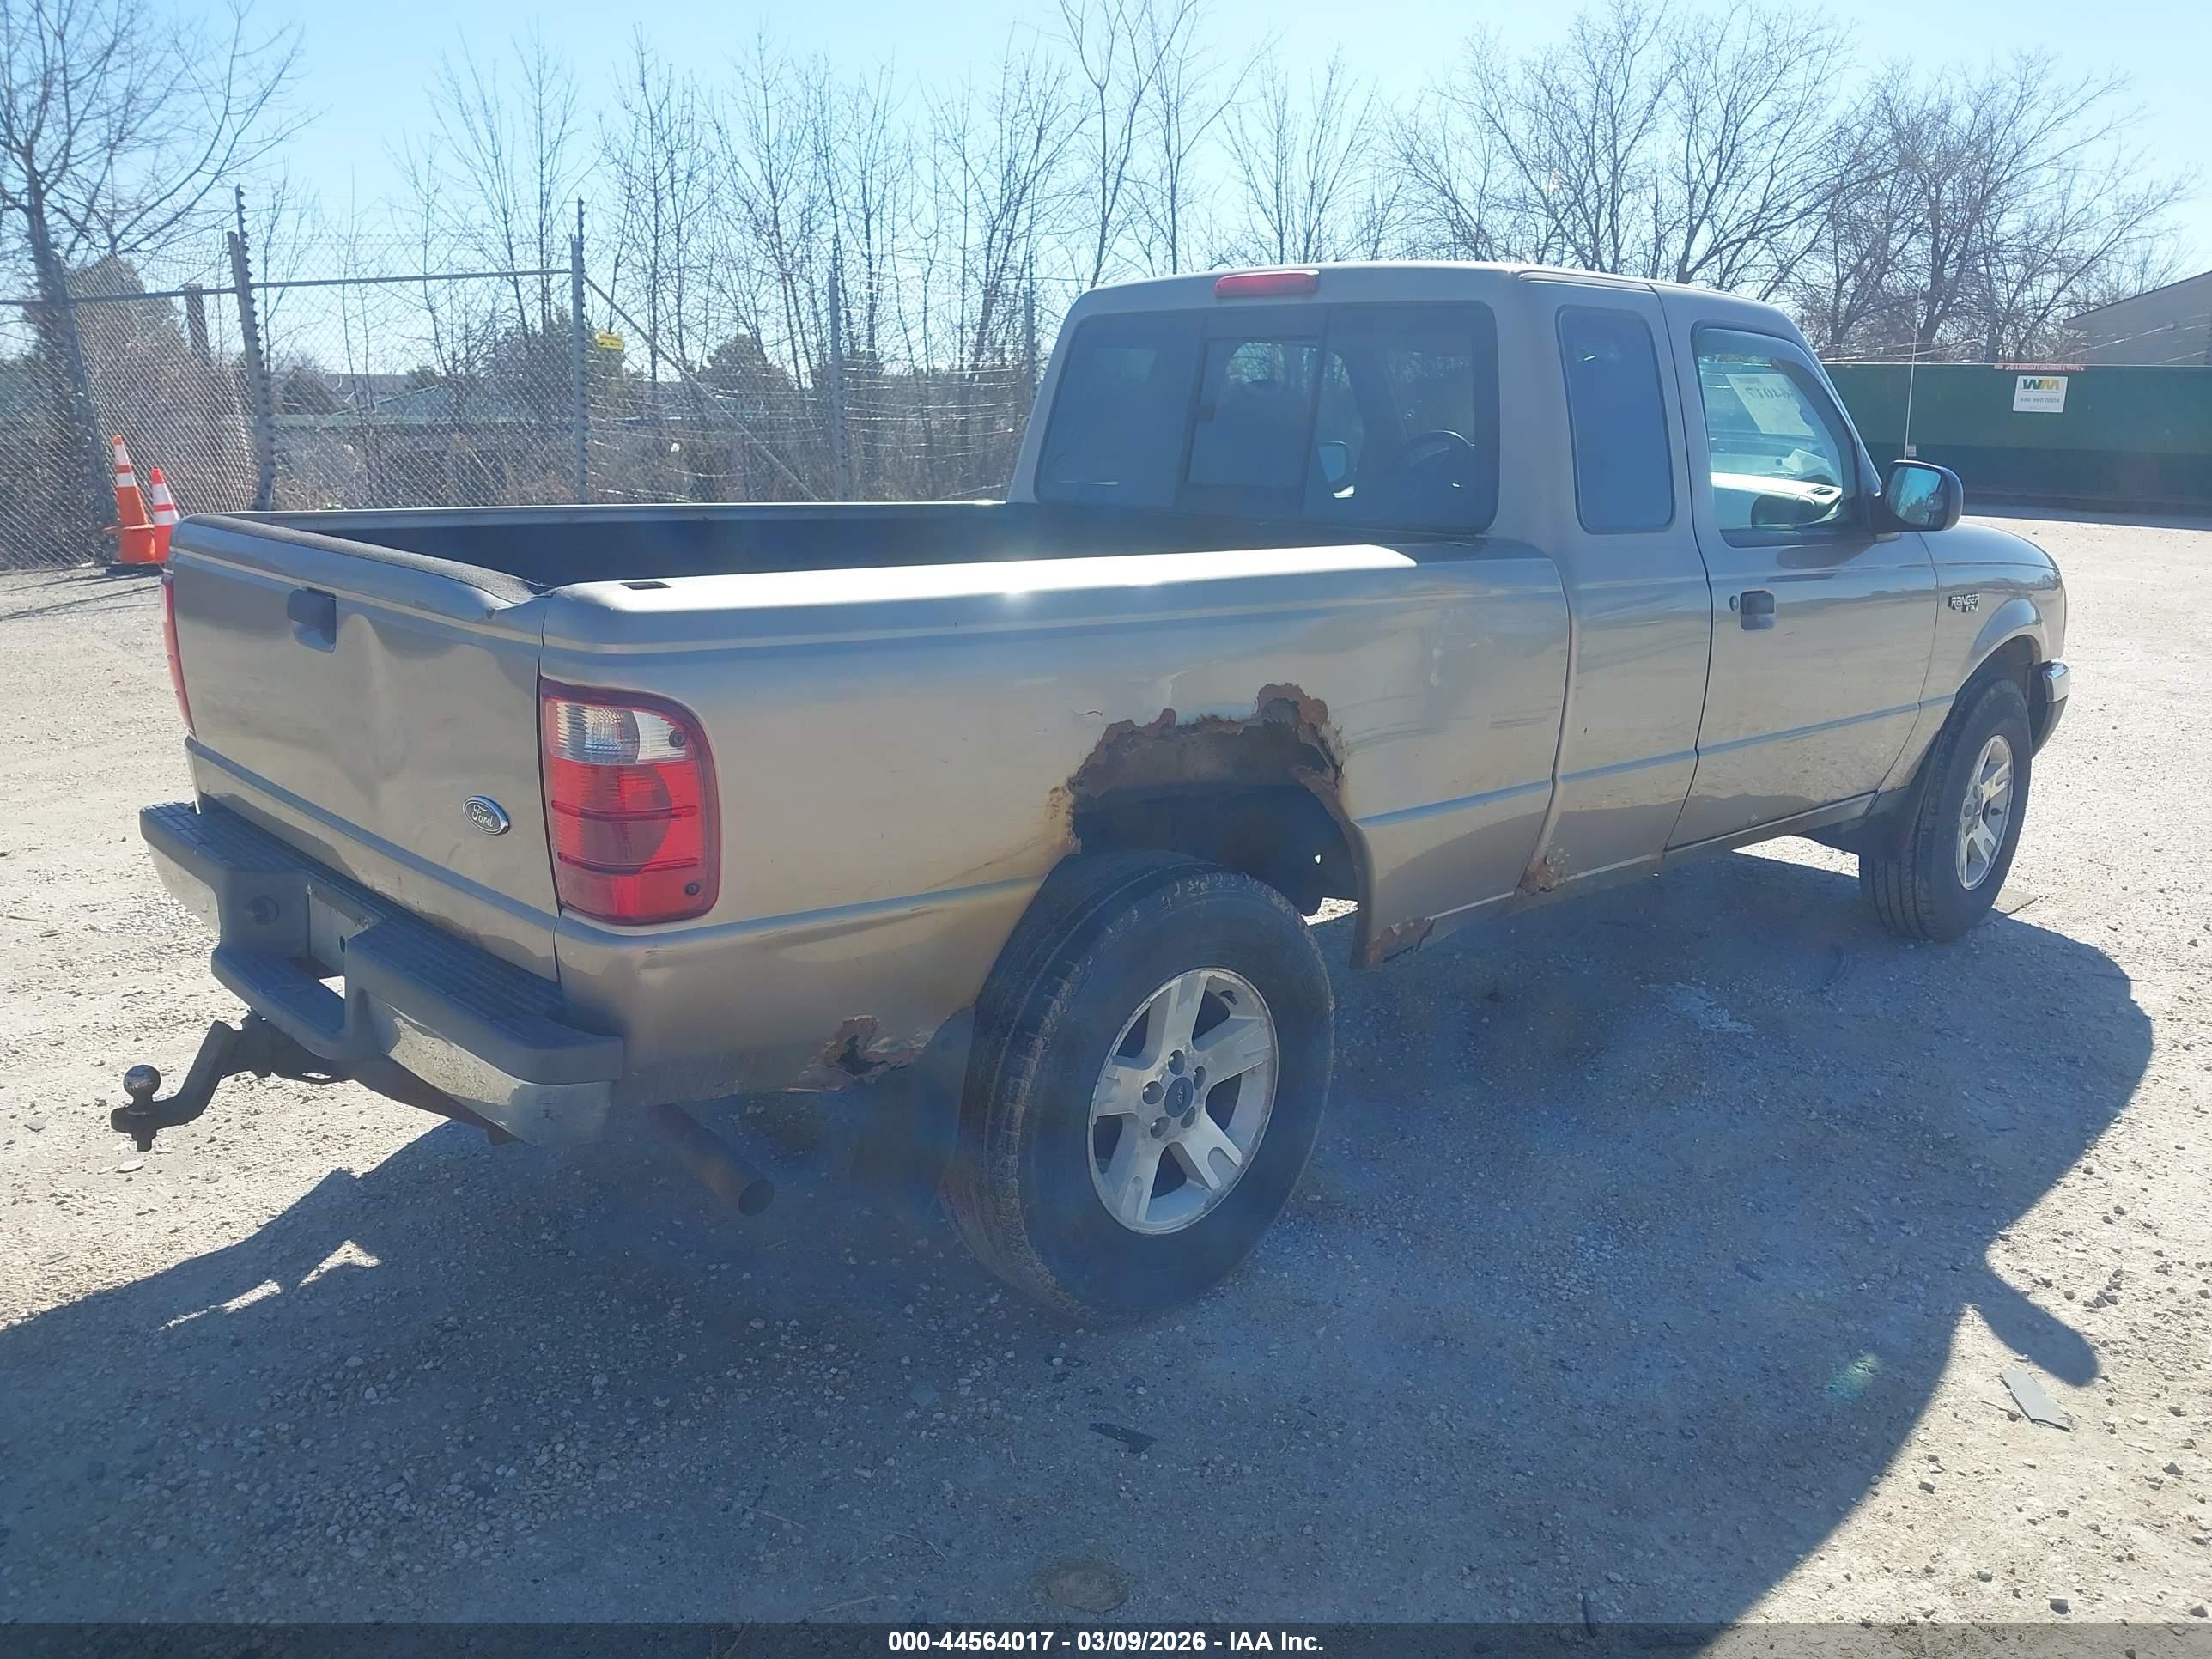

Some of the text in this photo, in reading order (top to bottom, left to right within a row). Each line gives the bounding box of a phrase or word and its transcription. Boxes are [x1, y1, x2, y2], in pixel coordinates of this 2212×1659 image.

[2022, 379, 2060, 390] WM
[1951, 593, 1979, 608] RANGER
[472, 804, 494, 827] Ford
